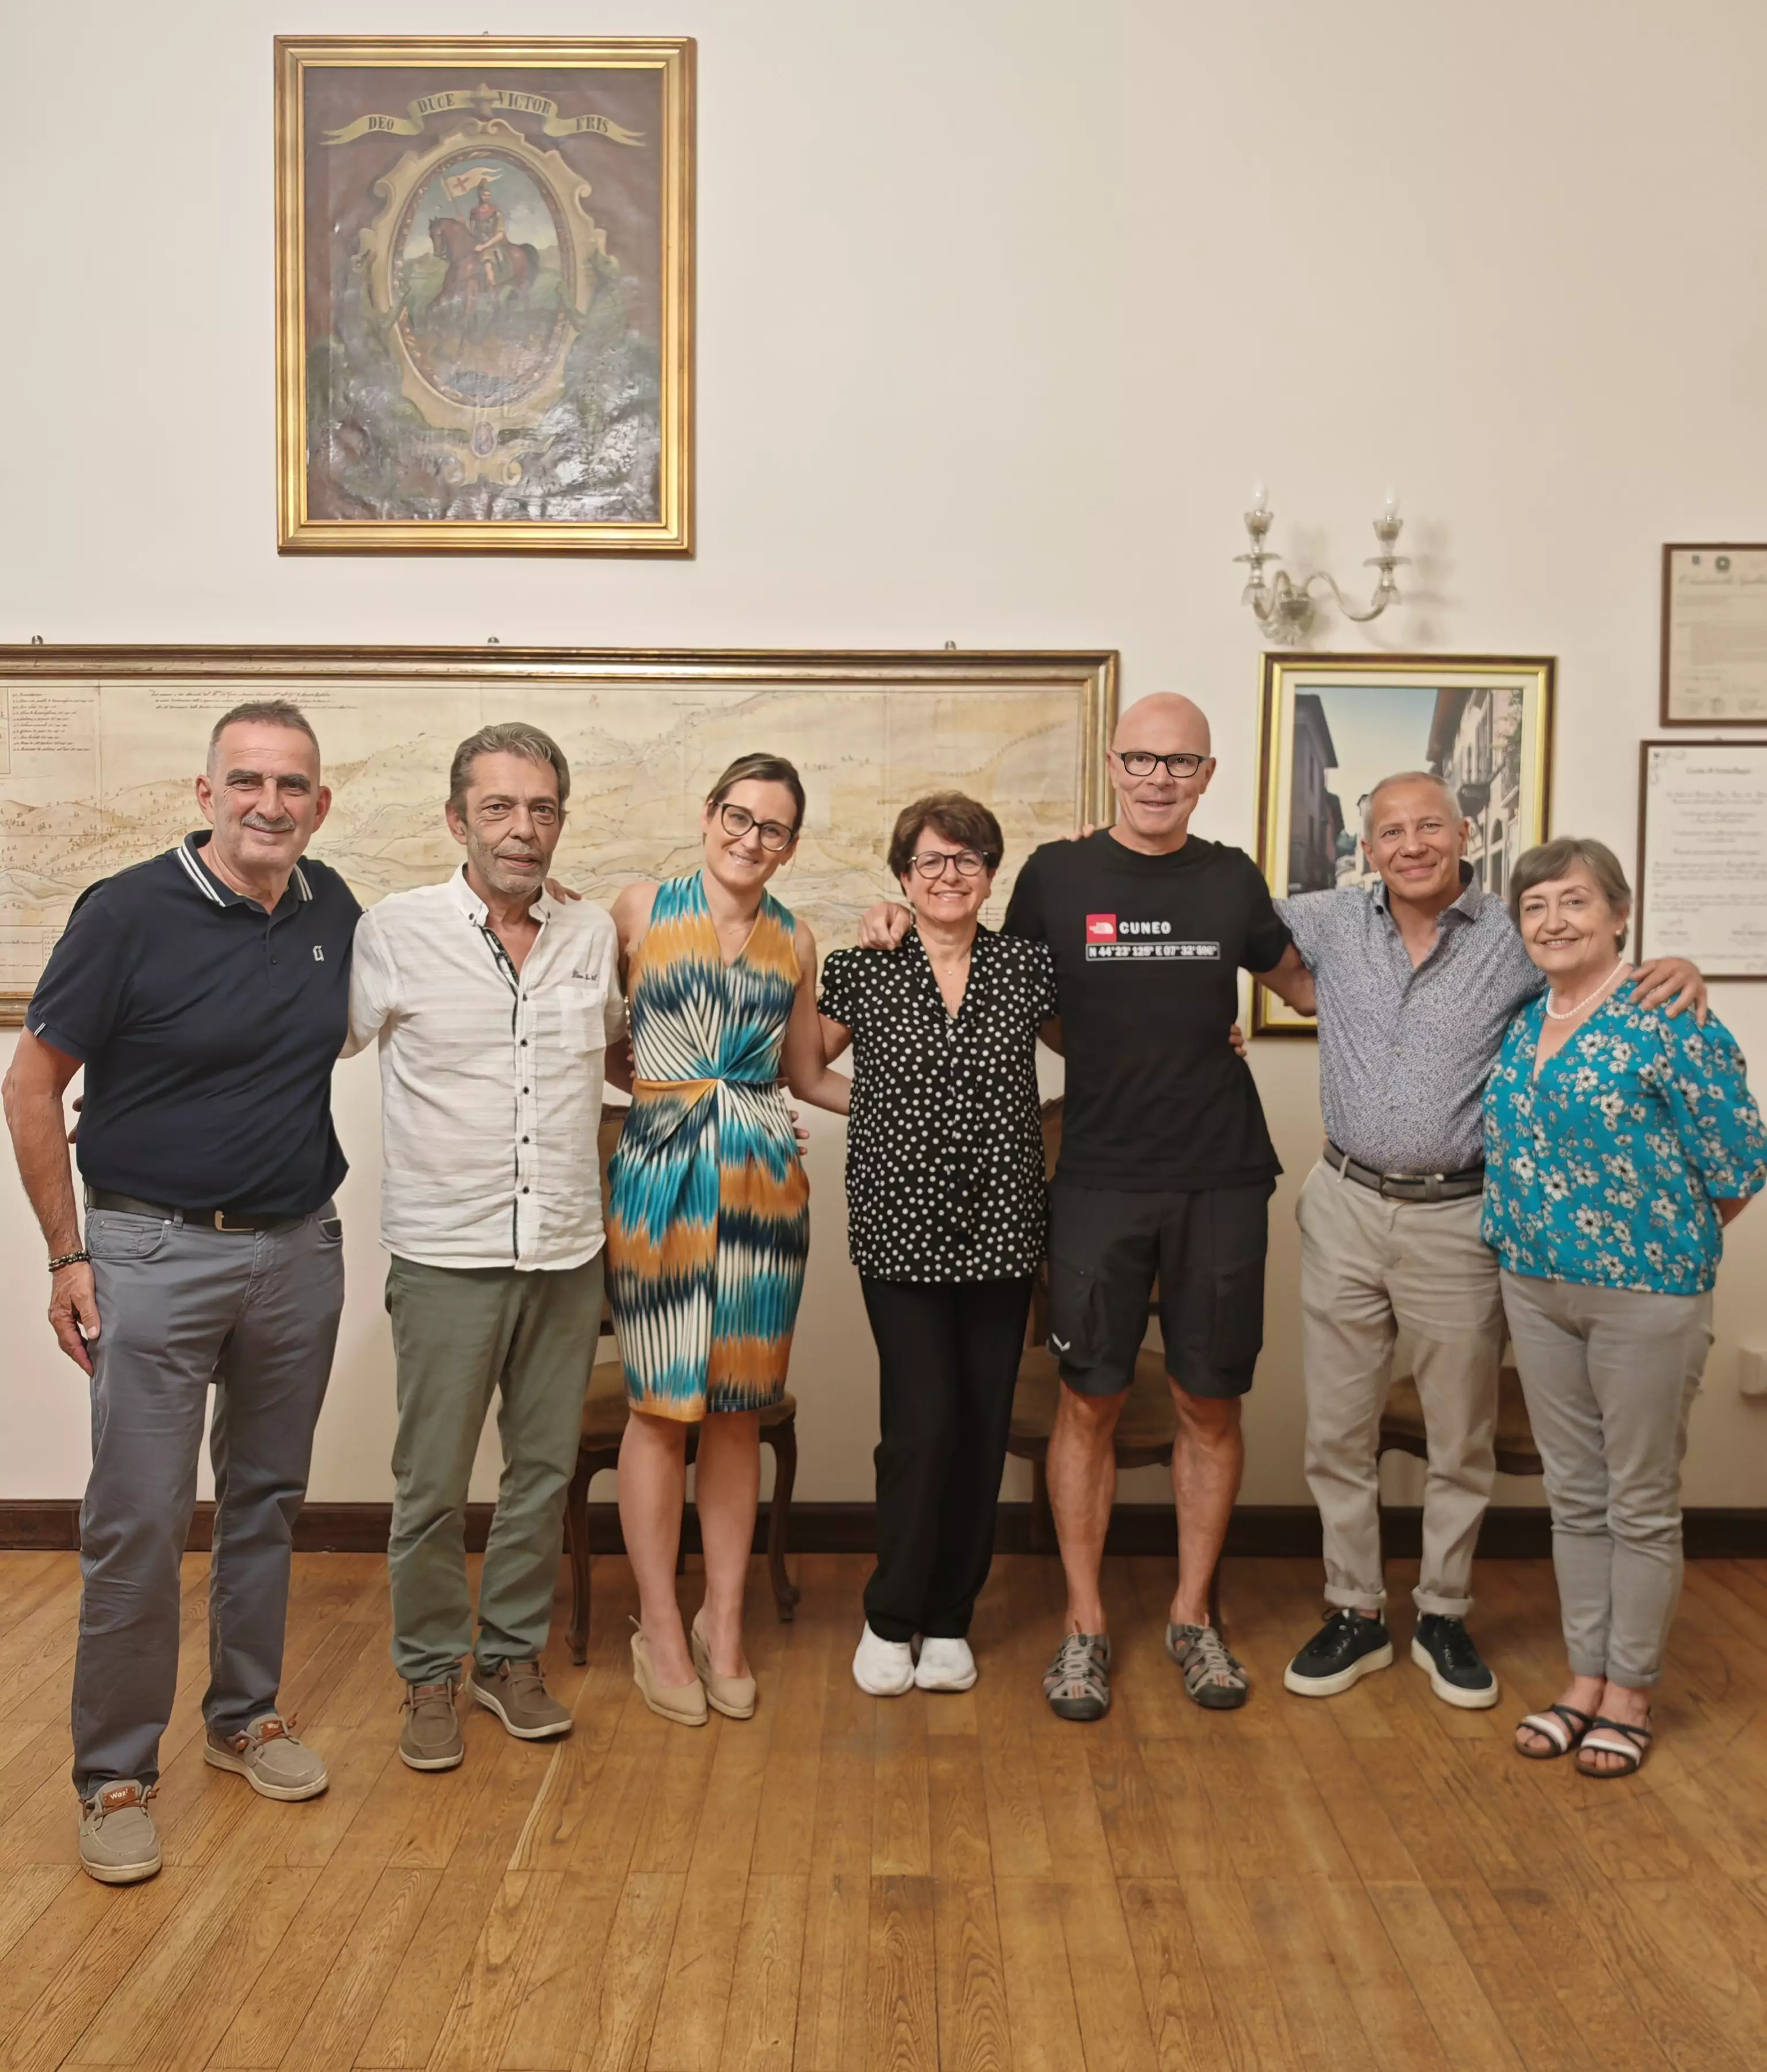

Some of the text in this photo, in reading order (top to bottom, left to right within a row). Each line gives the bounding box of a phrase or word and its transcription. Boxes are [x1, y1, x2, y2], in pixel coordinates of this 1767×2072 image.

[368, 116, 395, 131] DEO
[417, 93, 456, 113] DUCE
[497, 91, 552, 115] VICTOR
[1119, 921, 1172, 935] CUNEO
[1089, 946, 1097, 957] N
